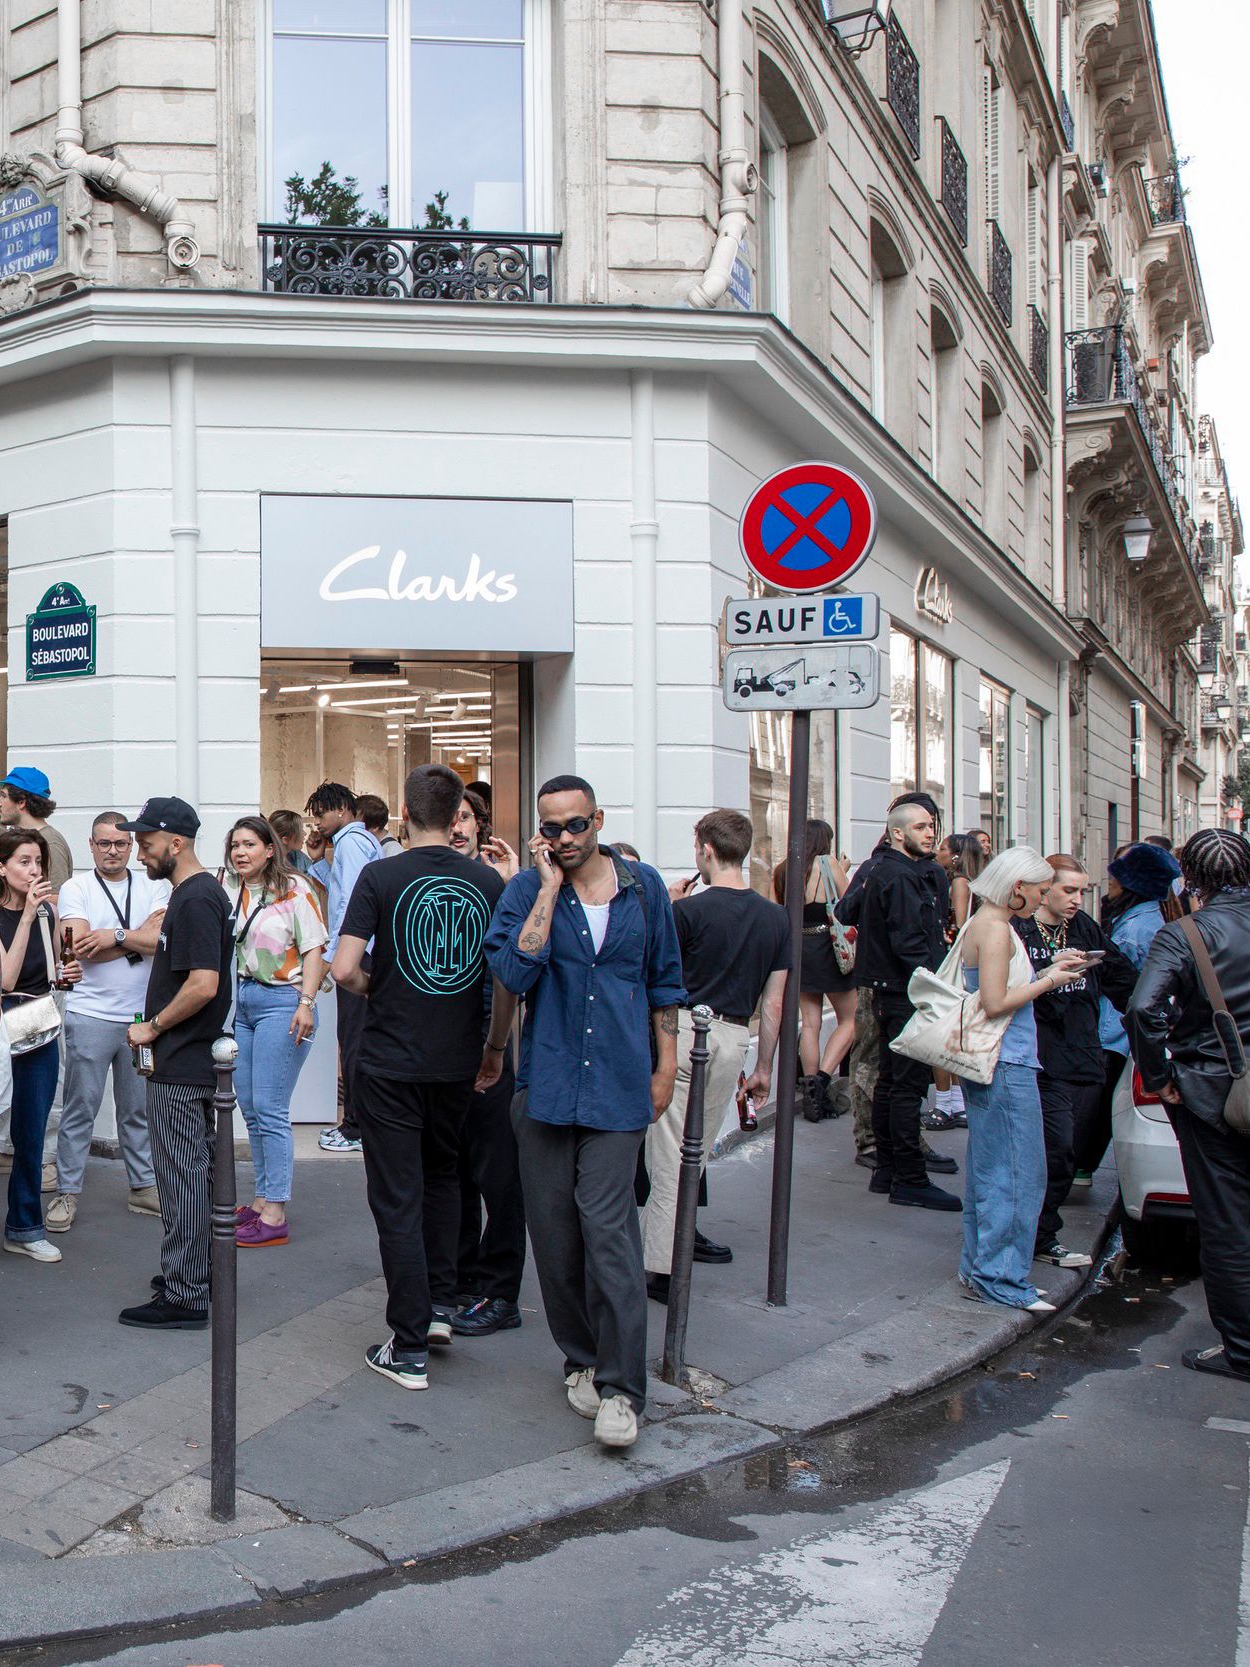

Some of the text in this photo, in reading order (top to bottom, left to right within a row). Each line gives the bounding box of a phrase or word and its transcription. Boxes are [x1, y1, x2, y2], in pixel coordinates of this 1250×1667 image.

[6, 240, 24, 257] DE
[319, 545, 518, 603] Clarks
[734, 606, 817, 635] SAUF
[32, 622, 89, 642] BOULEVARD
[31, 646, 90, 666] SÉBASTOPOL
